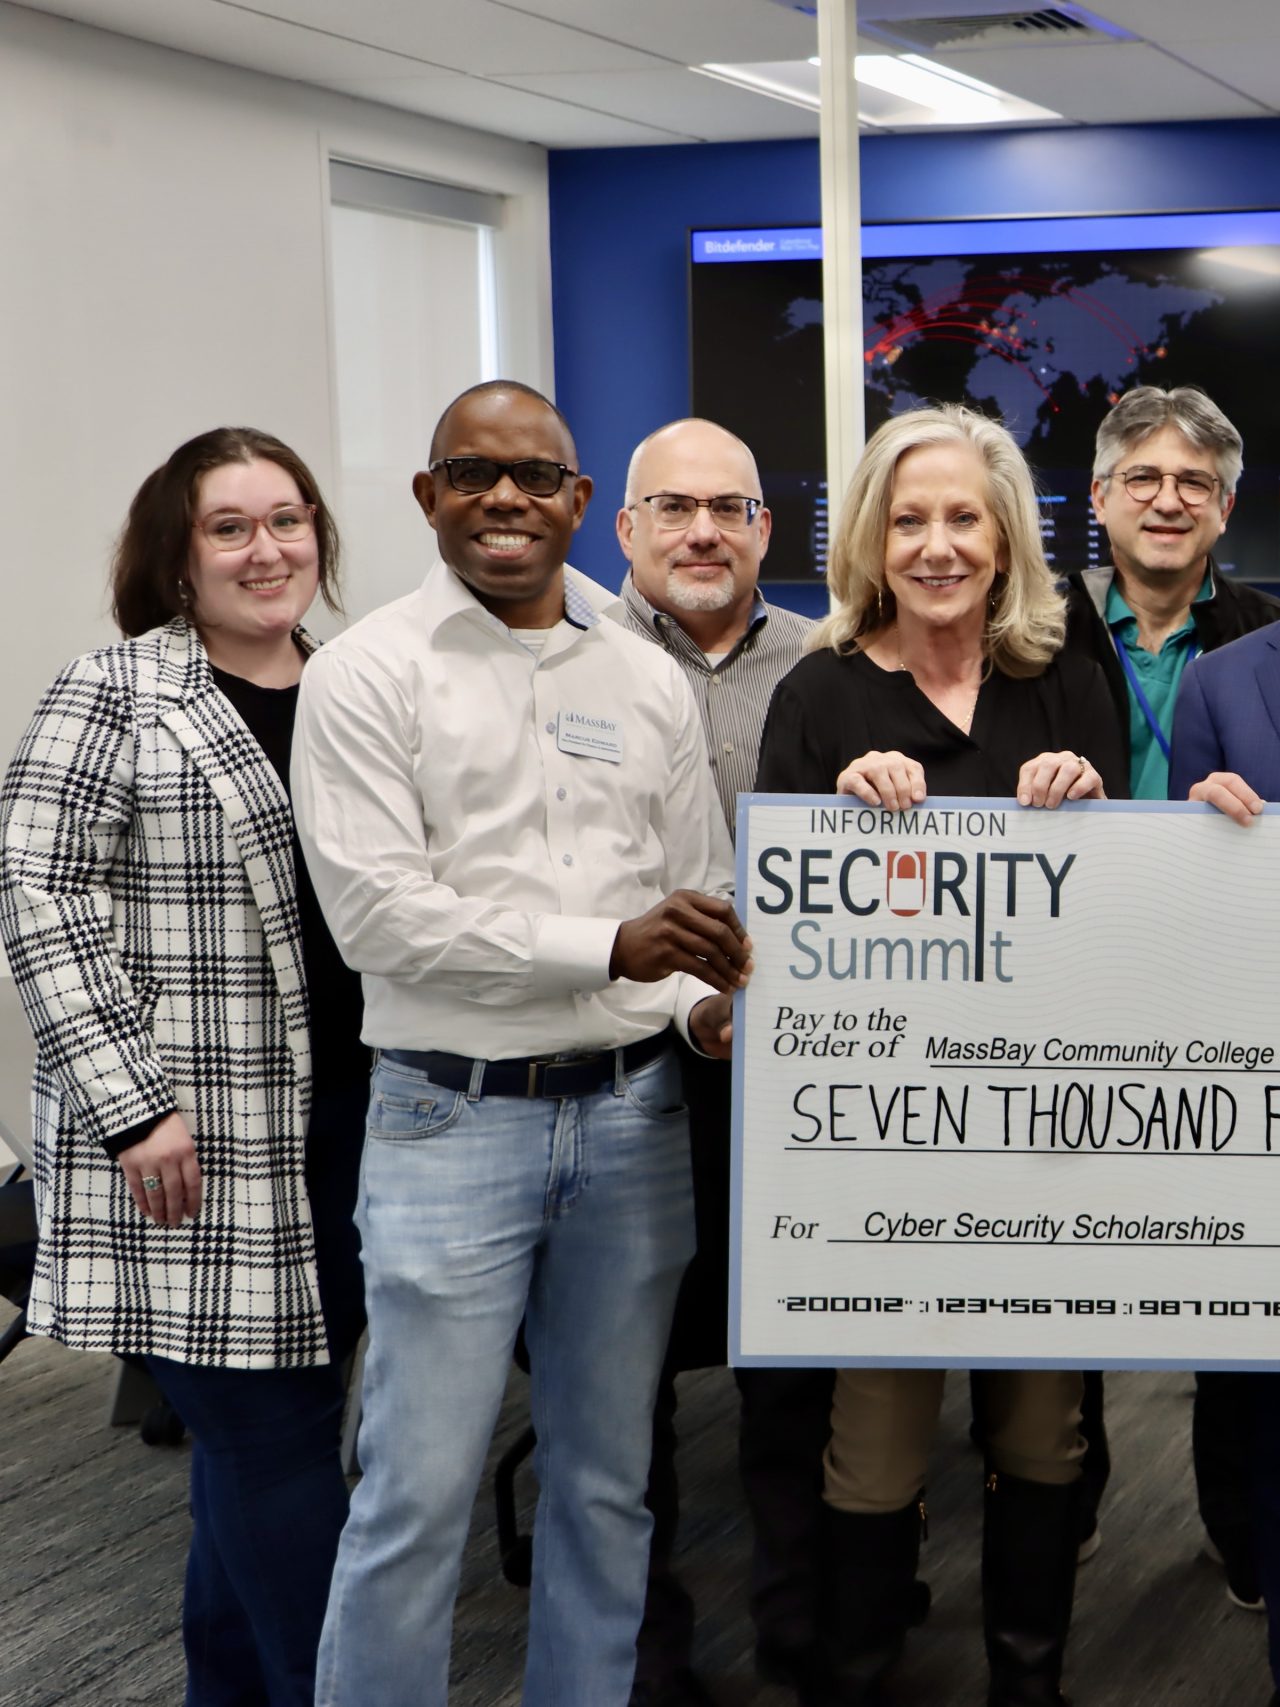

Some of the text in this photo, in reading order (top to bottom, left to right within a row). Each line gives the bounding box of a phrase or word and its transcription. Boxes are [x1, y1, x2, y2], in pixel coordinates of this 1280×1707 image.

[705, 239, 775, 253] Bitdefender
[811, 809, 1007, 837] INFORMATION
[789, 920, 1014, 983] Summit
[774, 1006, 908, 1036] Pay to the
[773, 1033, 905, 1058] Order of
[925, 1037, 1036, 1067] MassBay
[1043, 1038, 1178, 1068] Community
[1185, 1040, 1275, 1069] College
[791, 1083, 969, 1145] SEVEN
[988, 1082, 1237, 1152] THOUSAND
[770, 1214, 819, 1239] For
[864, 1211, 1245, 1246] Cyber Security Scholarships
